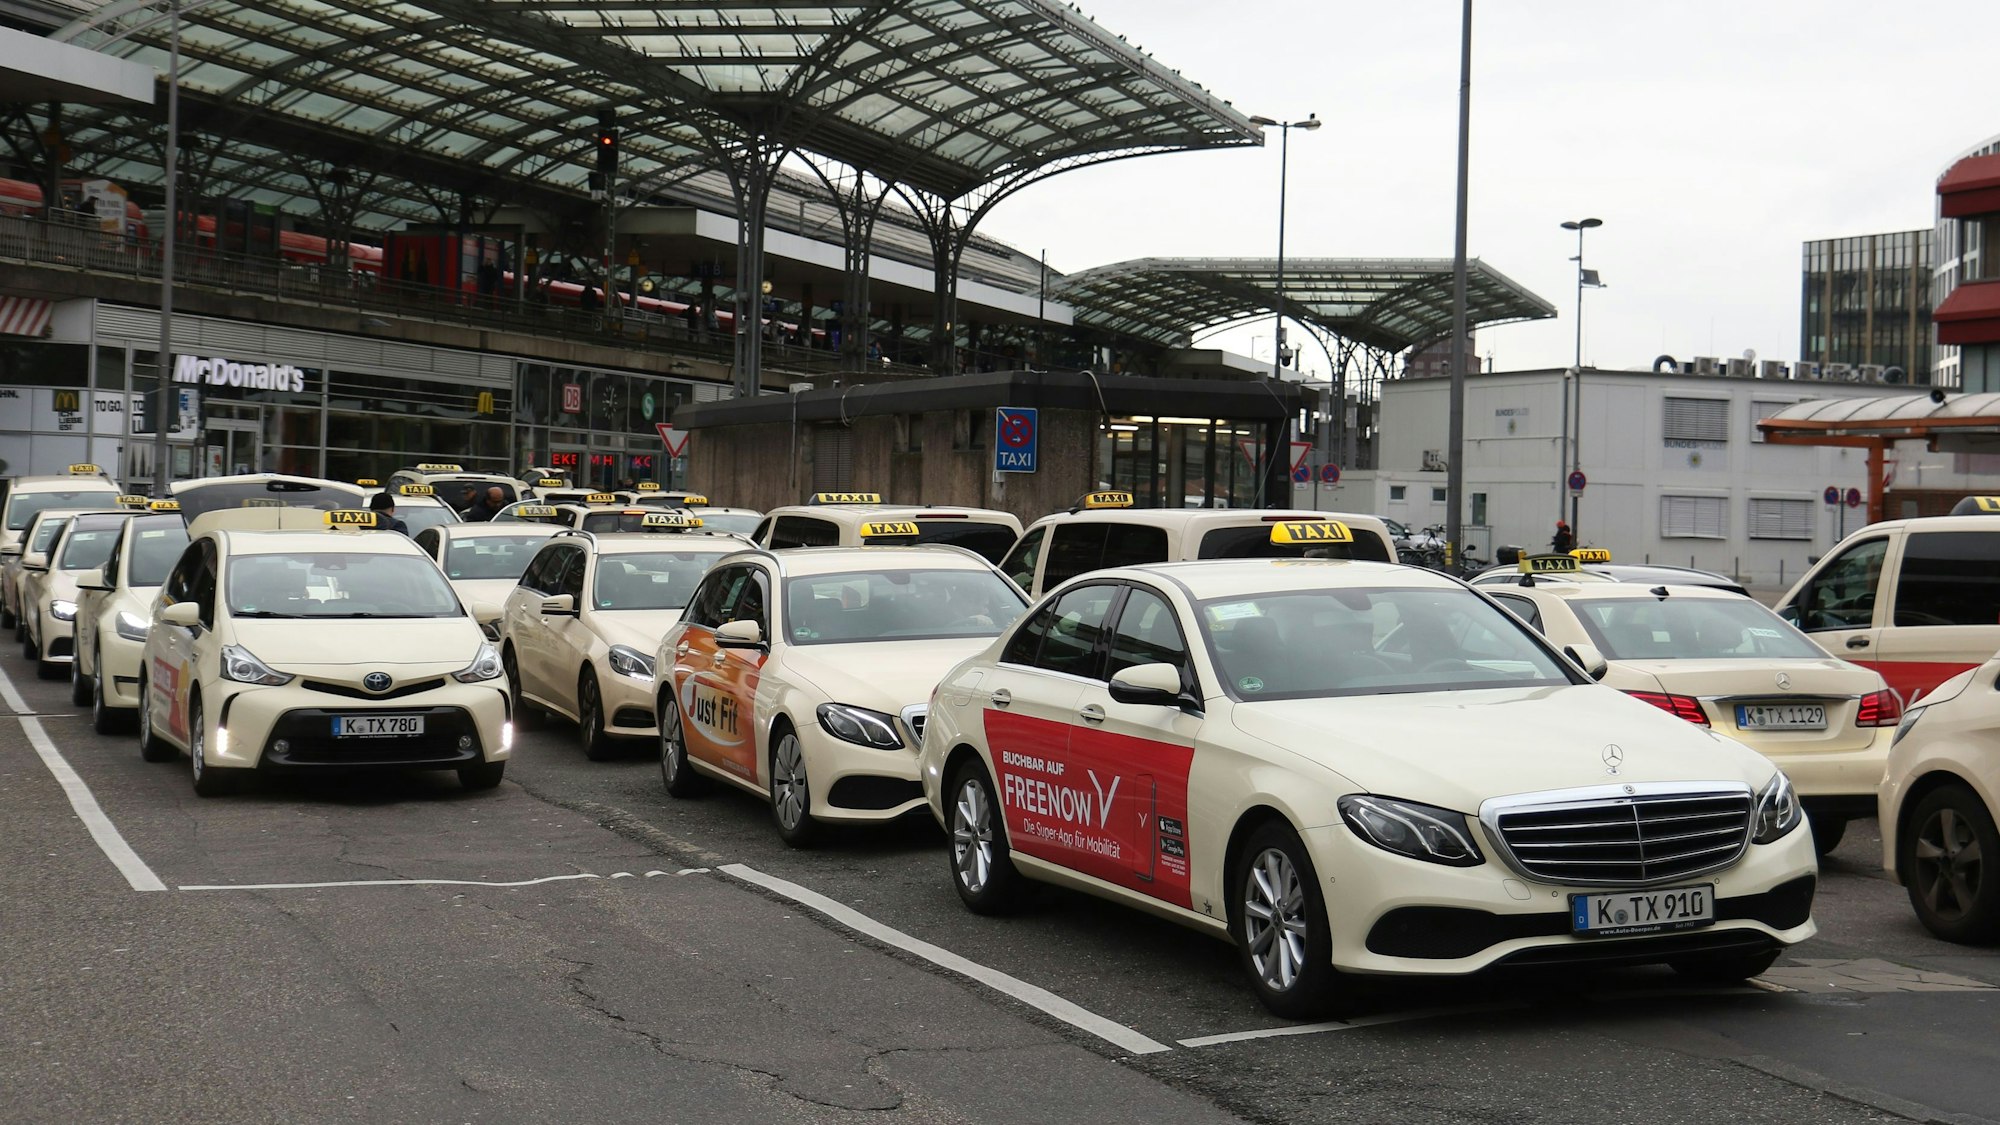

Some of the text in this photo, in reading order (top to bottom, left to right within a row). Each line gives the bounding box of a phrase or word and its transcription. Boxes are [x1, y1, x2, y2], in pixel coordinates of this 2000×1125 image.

[172, 354, 304, 393] McDonald's
[565, 388, 579, 408] DB
[999, 452, 1031, 467] TAXI
[408, 485, 429, 493] TAXI
[591, 494, 612, 502] TAXI
[831, 493, 869, 502] TAXI
[1096, 494, 1125, 503] TAXI
[157, 501, 179, 509] TAX
[525, 507, 552, 515] TAXI
[333, 511, 369, 523] TAXI
[649, 515, 682, 524] TAXI
[871, 523, 911, 533] TAXI
[1289, 524, 1343, 539] TAXI
[1580, 551, 1606, 560] TAXI
[1536, 560, 1571, 570] TAXI
[689, 678, 738, 736] Just Fit
[1746, 708, 1756, 724] K
[1766, 708, 1785, 723] TX
[1789, 707, 1823, 723] 1129
[346, 719, 356, 733] K
[366, 719, 386, 732] TX
[389, 718, 417, 732] 780
[1002, 750, 1065, 776] BUCHBAR AUF
[1004, 773, 1091, 826] FREENOW
[1023, 817, 1121, 859] Die Super-App für Mobilität
[1597, 898, 1613, 925] K
[1629, 895, 1659, 922] TX
[1664, 890, 1703, 919] 910
